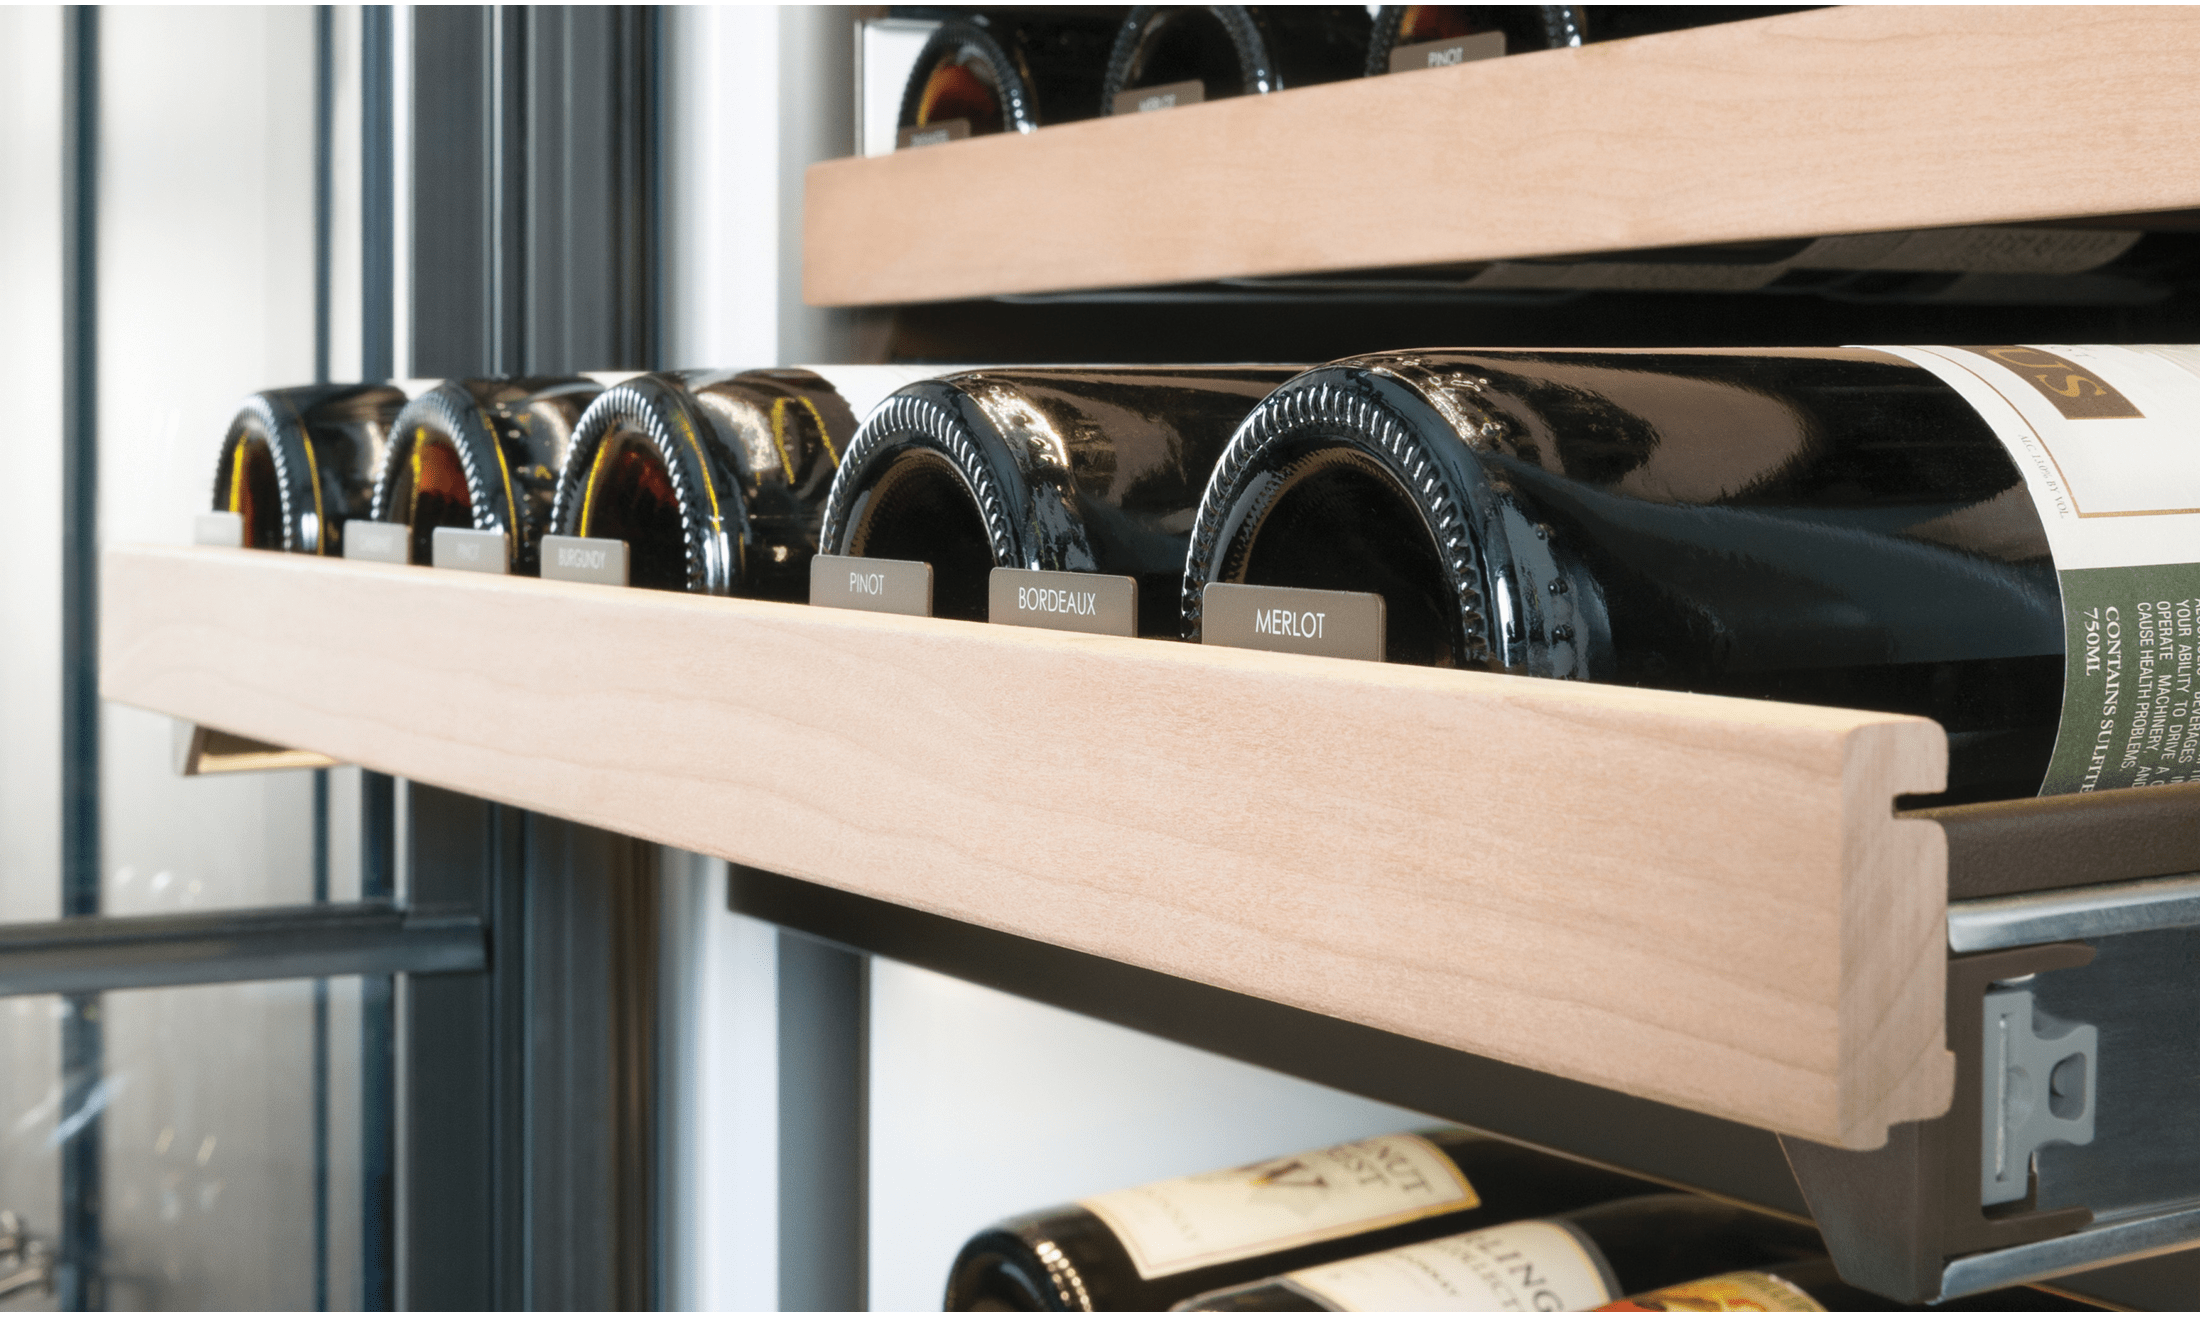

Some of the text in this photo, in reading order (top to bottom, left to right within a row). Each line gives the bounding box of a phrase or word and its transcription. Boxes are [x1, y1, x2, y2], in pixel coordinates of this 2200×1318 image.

[2045, 480, 2061, 494] BY
[2054, 496, 2069, 519] VOL.
[558, 547, 606, 570] BURGUNDY
[849, 573, 884, 595] PINOT
[1018, 587, 1096, 616] BORDEAUX
[1255, 609, 1325, 639] MERLOT
[2156, 601, 2173, 660] OPERATE
[2176, 599, 2192, 637] YOUR
[2083, 607, 2100, 676] 750ML
[2103, 606, 2121, 716] CONTAINS
[2176, 644, 2192, 693] ABILITY
[2119, 602, 2154, 772] CAUSE HEALTH PROBLEMS.
[2143, 674, 2172, 754] MACHINERY,
[2172, 700, 2188, 717] TO
[2161, 724, 2183, 760] DRIVE
[2155, 766, 2170, 775] A
